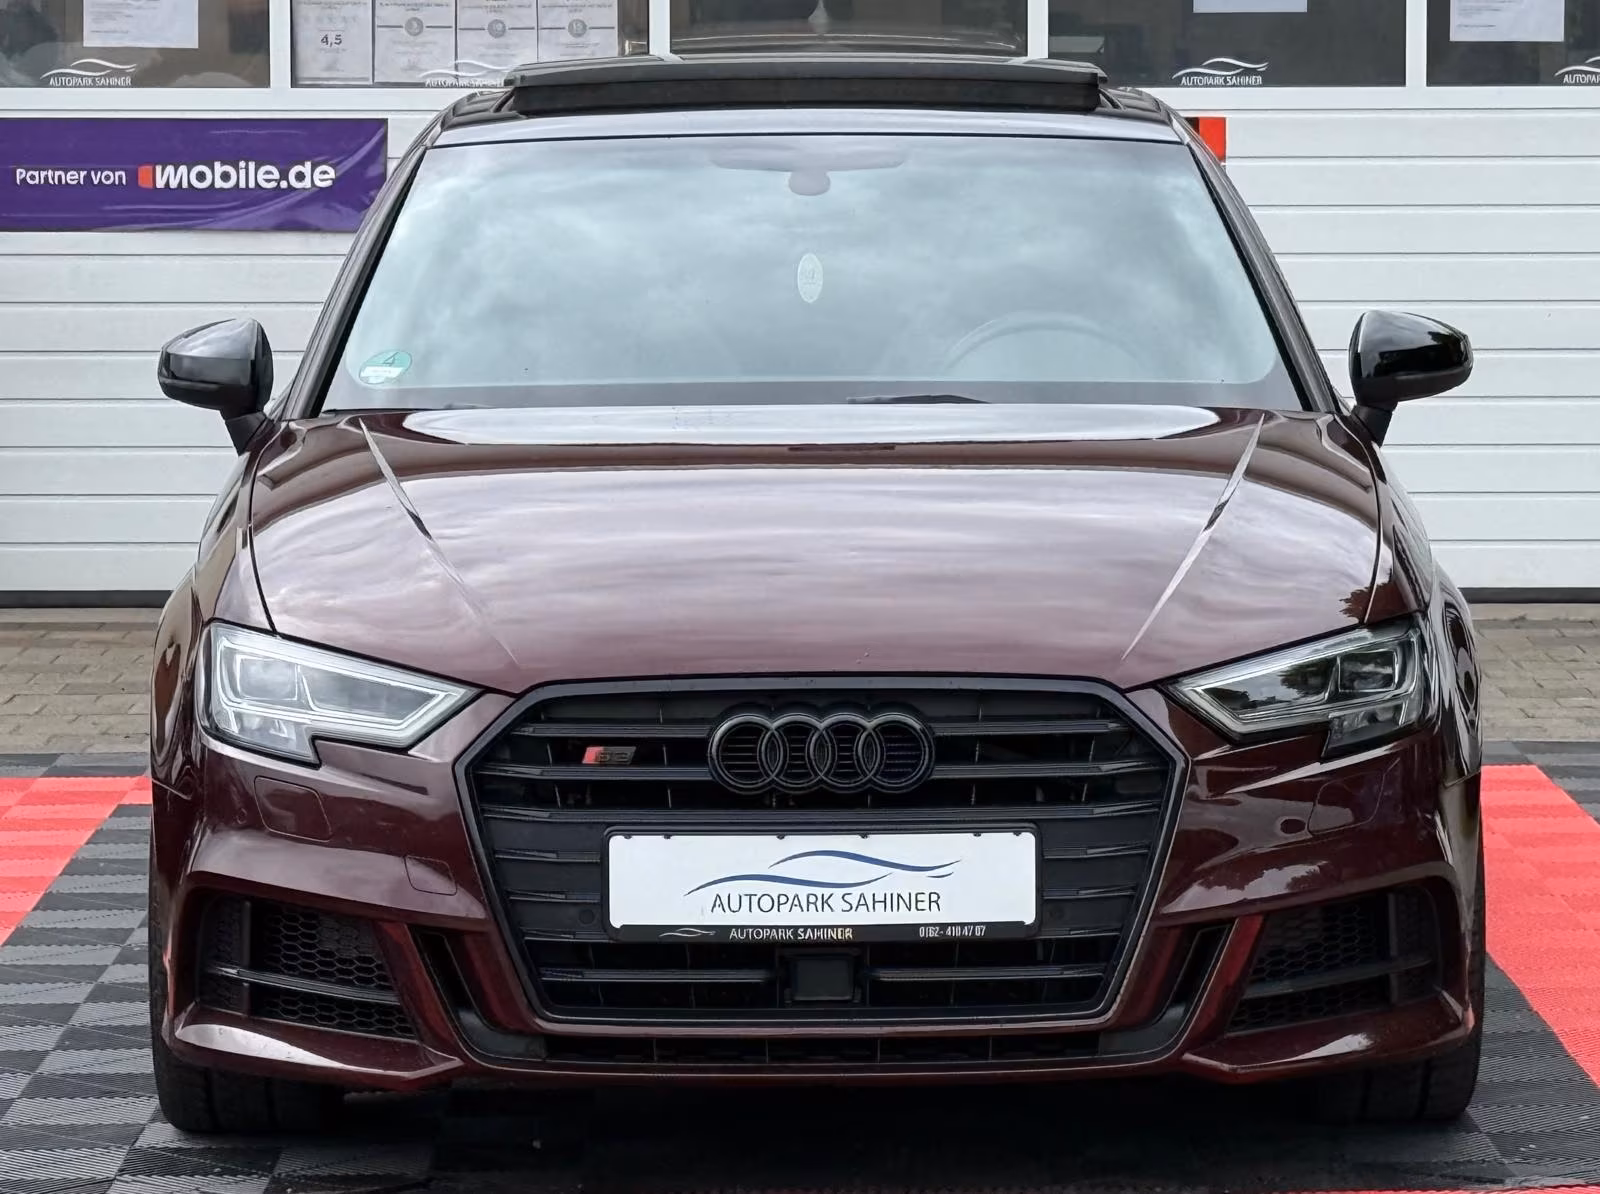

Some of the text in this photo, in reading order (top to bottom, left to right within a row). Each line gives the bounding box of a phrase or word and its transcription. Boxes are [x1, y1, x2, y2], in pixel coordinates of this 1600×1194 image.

[320, 34, 343, 48] 4,5
[49, 76, 94, 87] AUTOPARK
[1180, 76, 1225, 86] AUTOPARK
[16, 160, 336, 189] Partner von mobile.de
[711, 892, 941, 913] AUTOPARK SAHINER
[729, 927, 853, 940] AUTOPARK SAHINER
